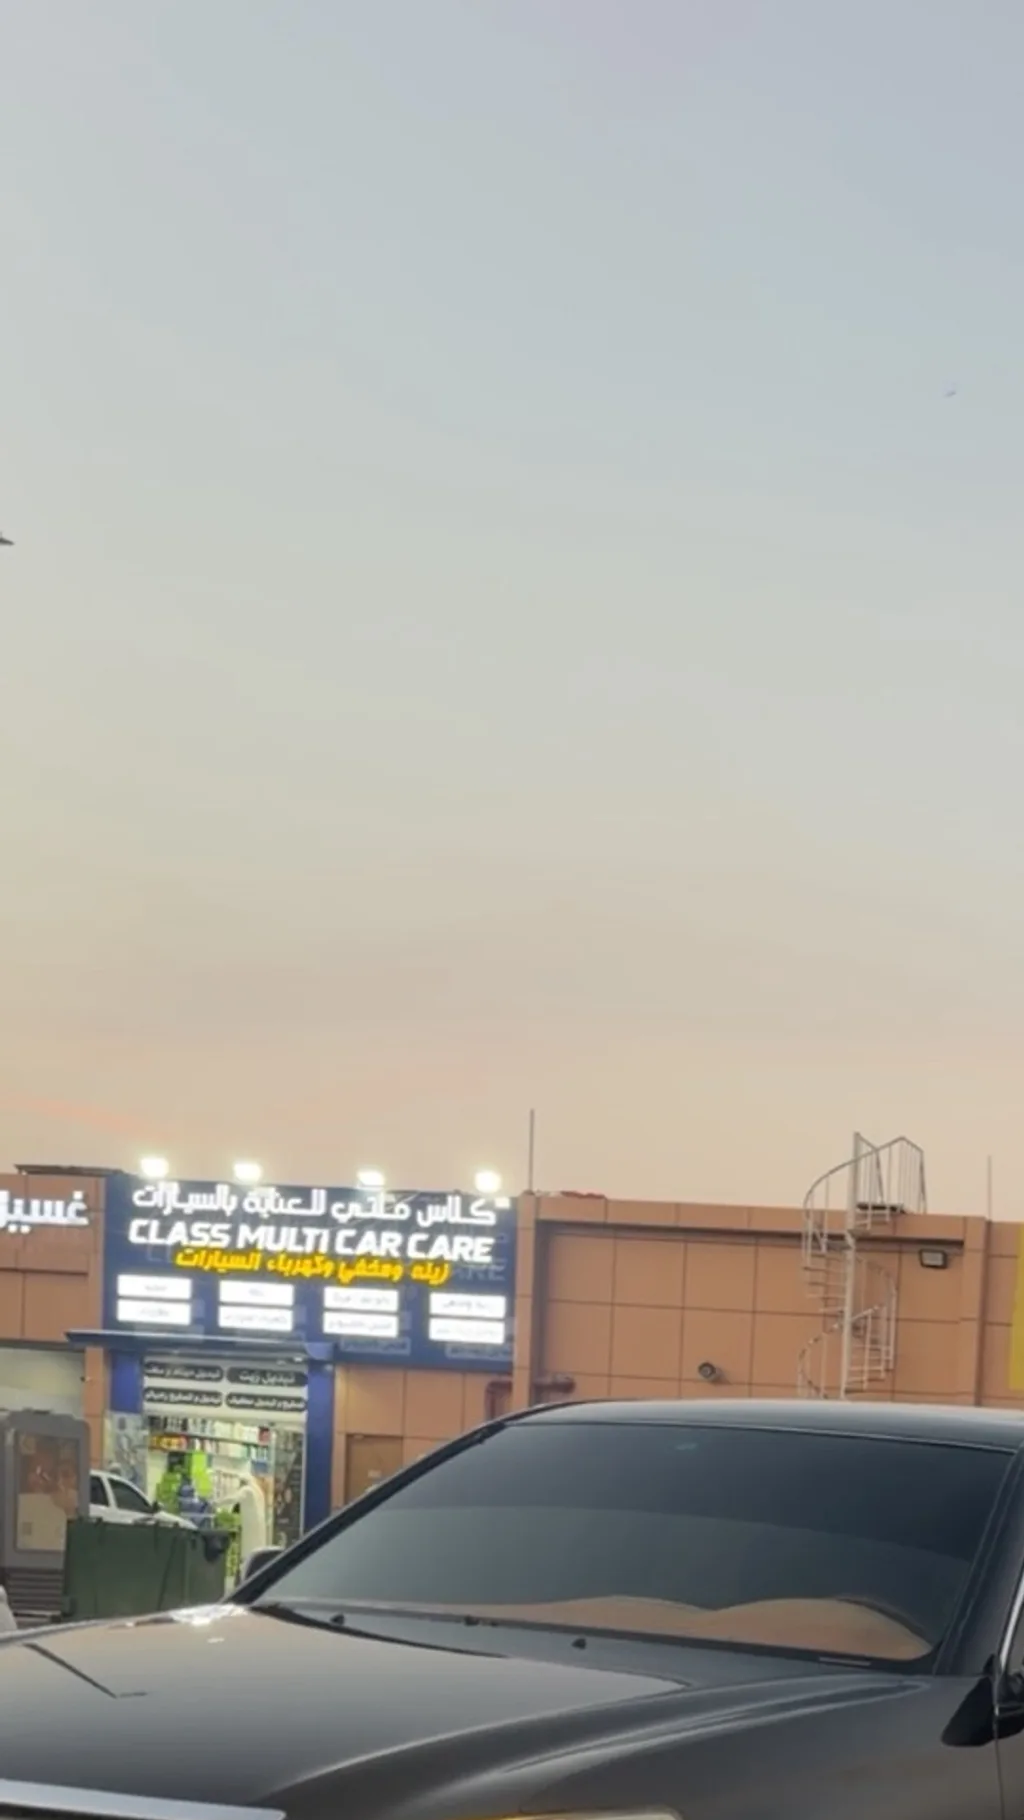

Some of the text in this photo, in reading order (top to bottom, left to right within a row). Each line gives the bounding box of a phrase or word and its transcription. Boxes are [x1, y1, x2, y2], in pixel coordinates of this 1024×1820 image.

[132, 1181, 238, 1216] بالسيارات
[331, 1191, 411, 1224] ملتي
[417, 1194, 497, 1228] كلاس
[128, 1218, 496, 1263] CLASS MULTI CAR CARE
[175, 1248, 262, 1273] السيارات
